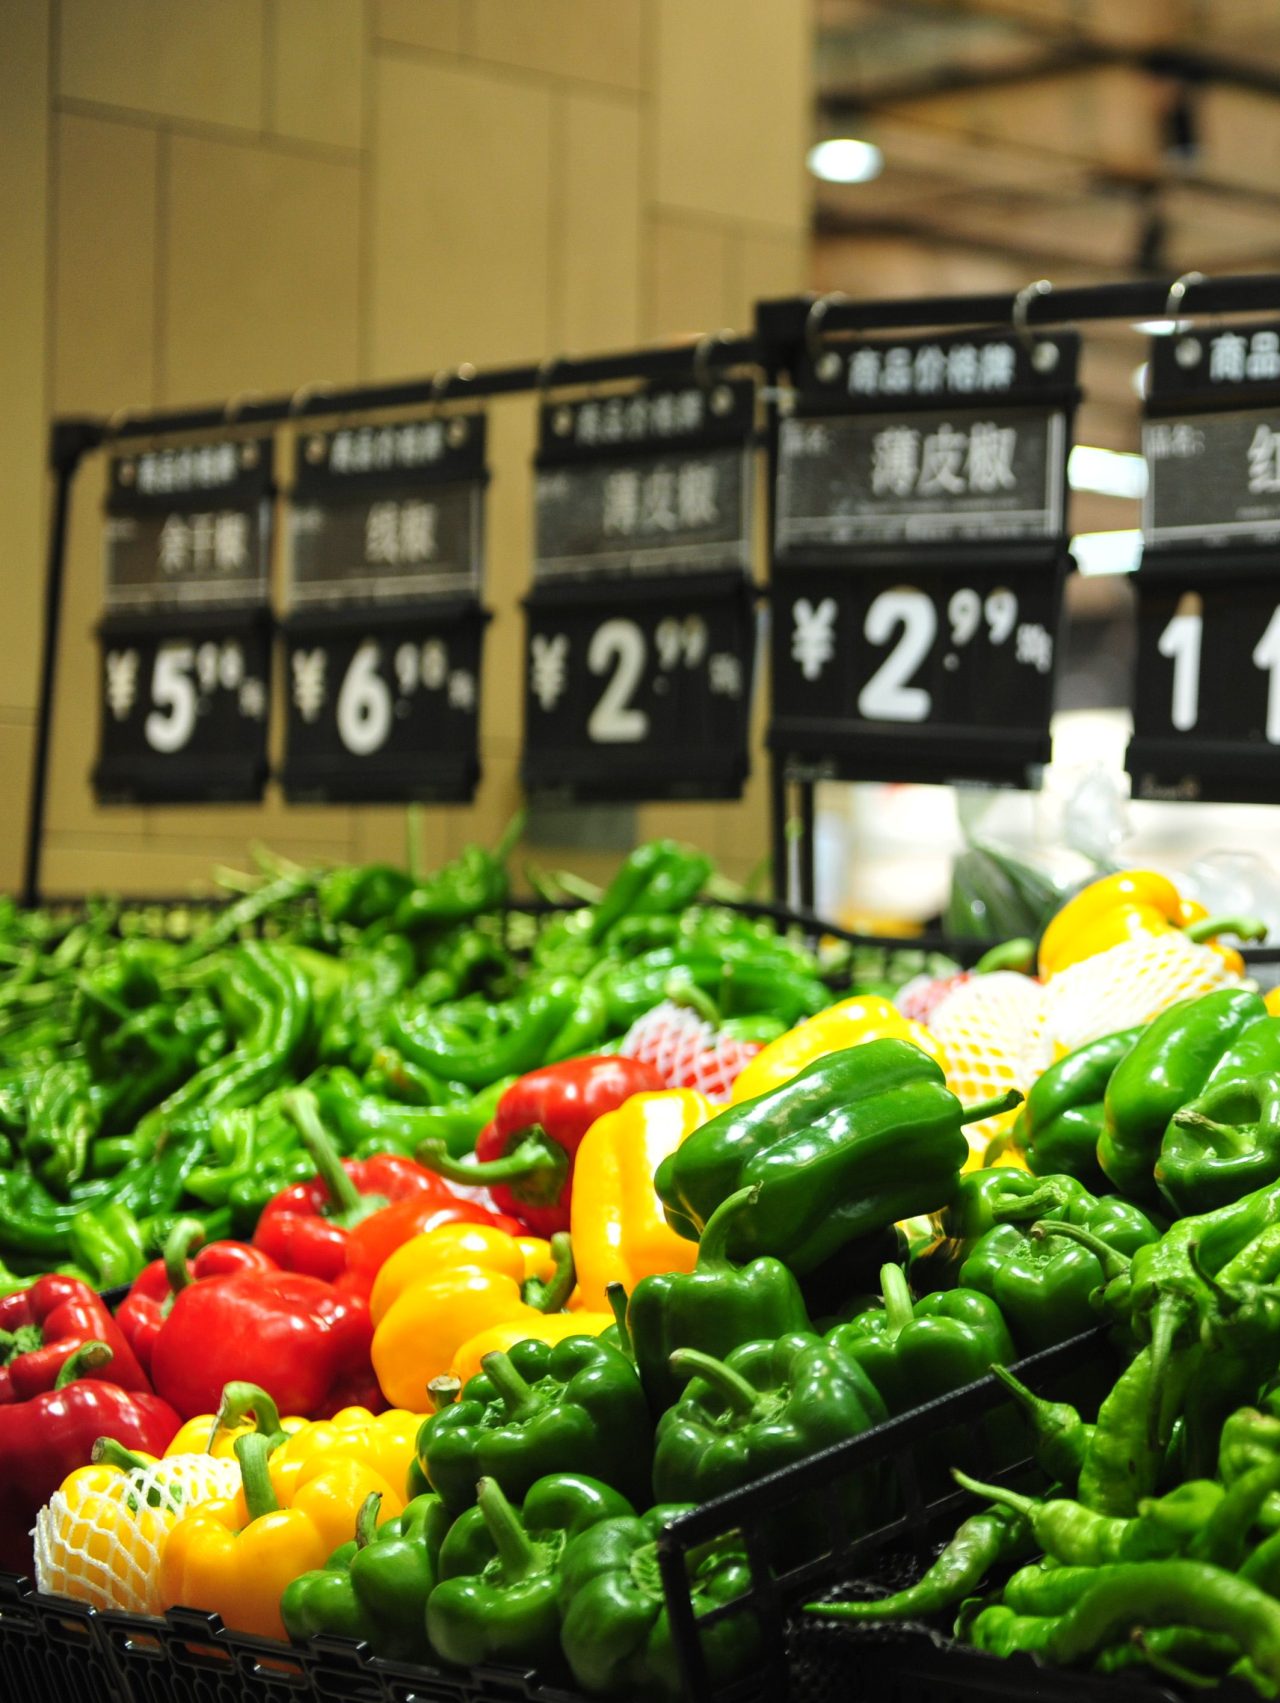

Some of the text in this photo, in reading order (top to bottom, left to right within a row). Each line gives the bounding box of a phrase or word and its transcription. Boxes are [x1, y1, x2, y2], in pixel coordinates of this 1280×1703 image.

[848, 343, 1016, 394] 商品价格牌
[871, 423, 1017, 497] 薄皮椒
